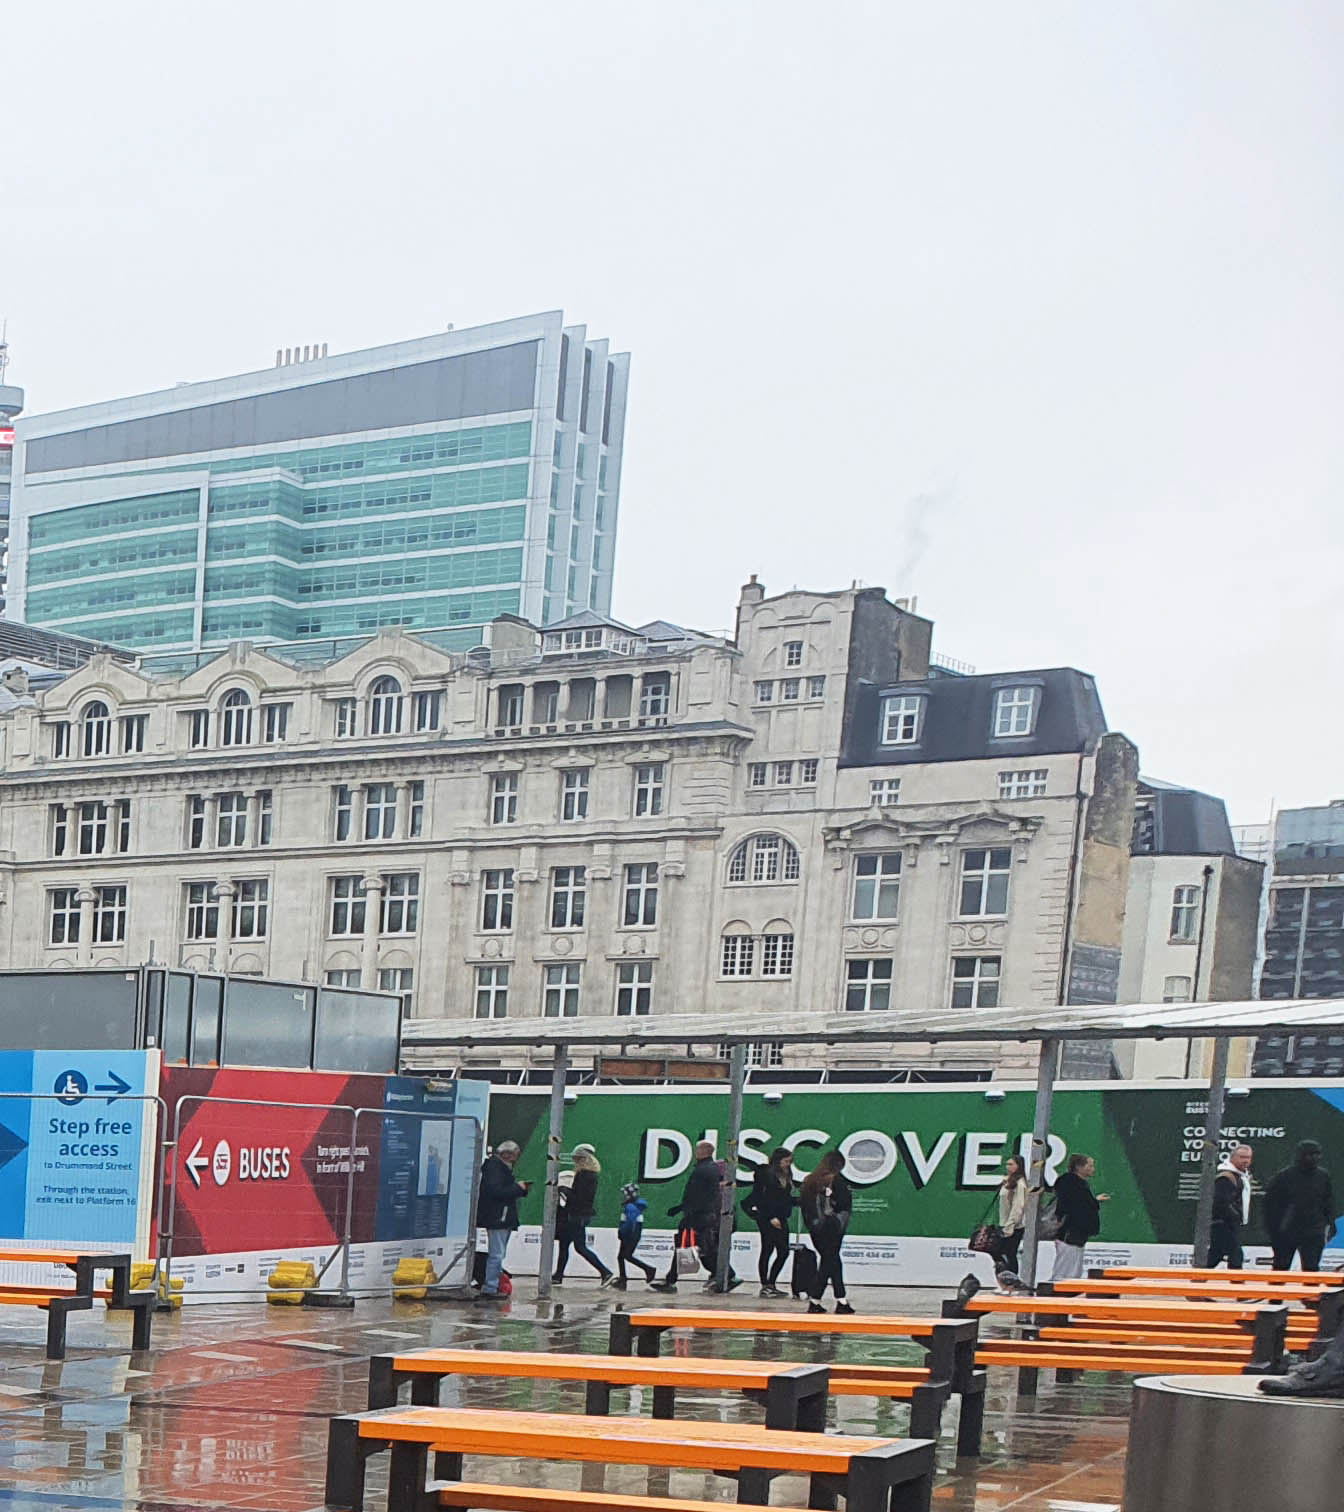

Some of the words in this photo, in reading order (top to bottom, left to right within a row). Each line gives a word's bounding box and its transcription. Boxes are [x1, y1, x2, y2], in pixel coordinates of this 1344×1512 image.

[48, 1118, 90, 1139] Step
[94, 1117, 132, 1135] free
[1183, 1126, 1286, 1138] CONECTING
[58, 1143, 119, 1157] access
[44, 1161, 53, 1169] to
[55, 1161, 103, 1170] Drummond
[239, 1147, 291, 1179] BUSES
[44, 1185, 78, 1196] Through
[81, 1186, 95, 1195] the
[75, 1197, 84, 1205] to
[86, 1197, 124, 1206] Platform
